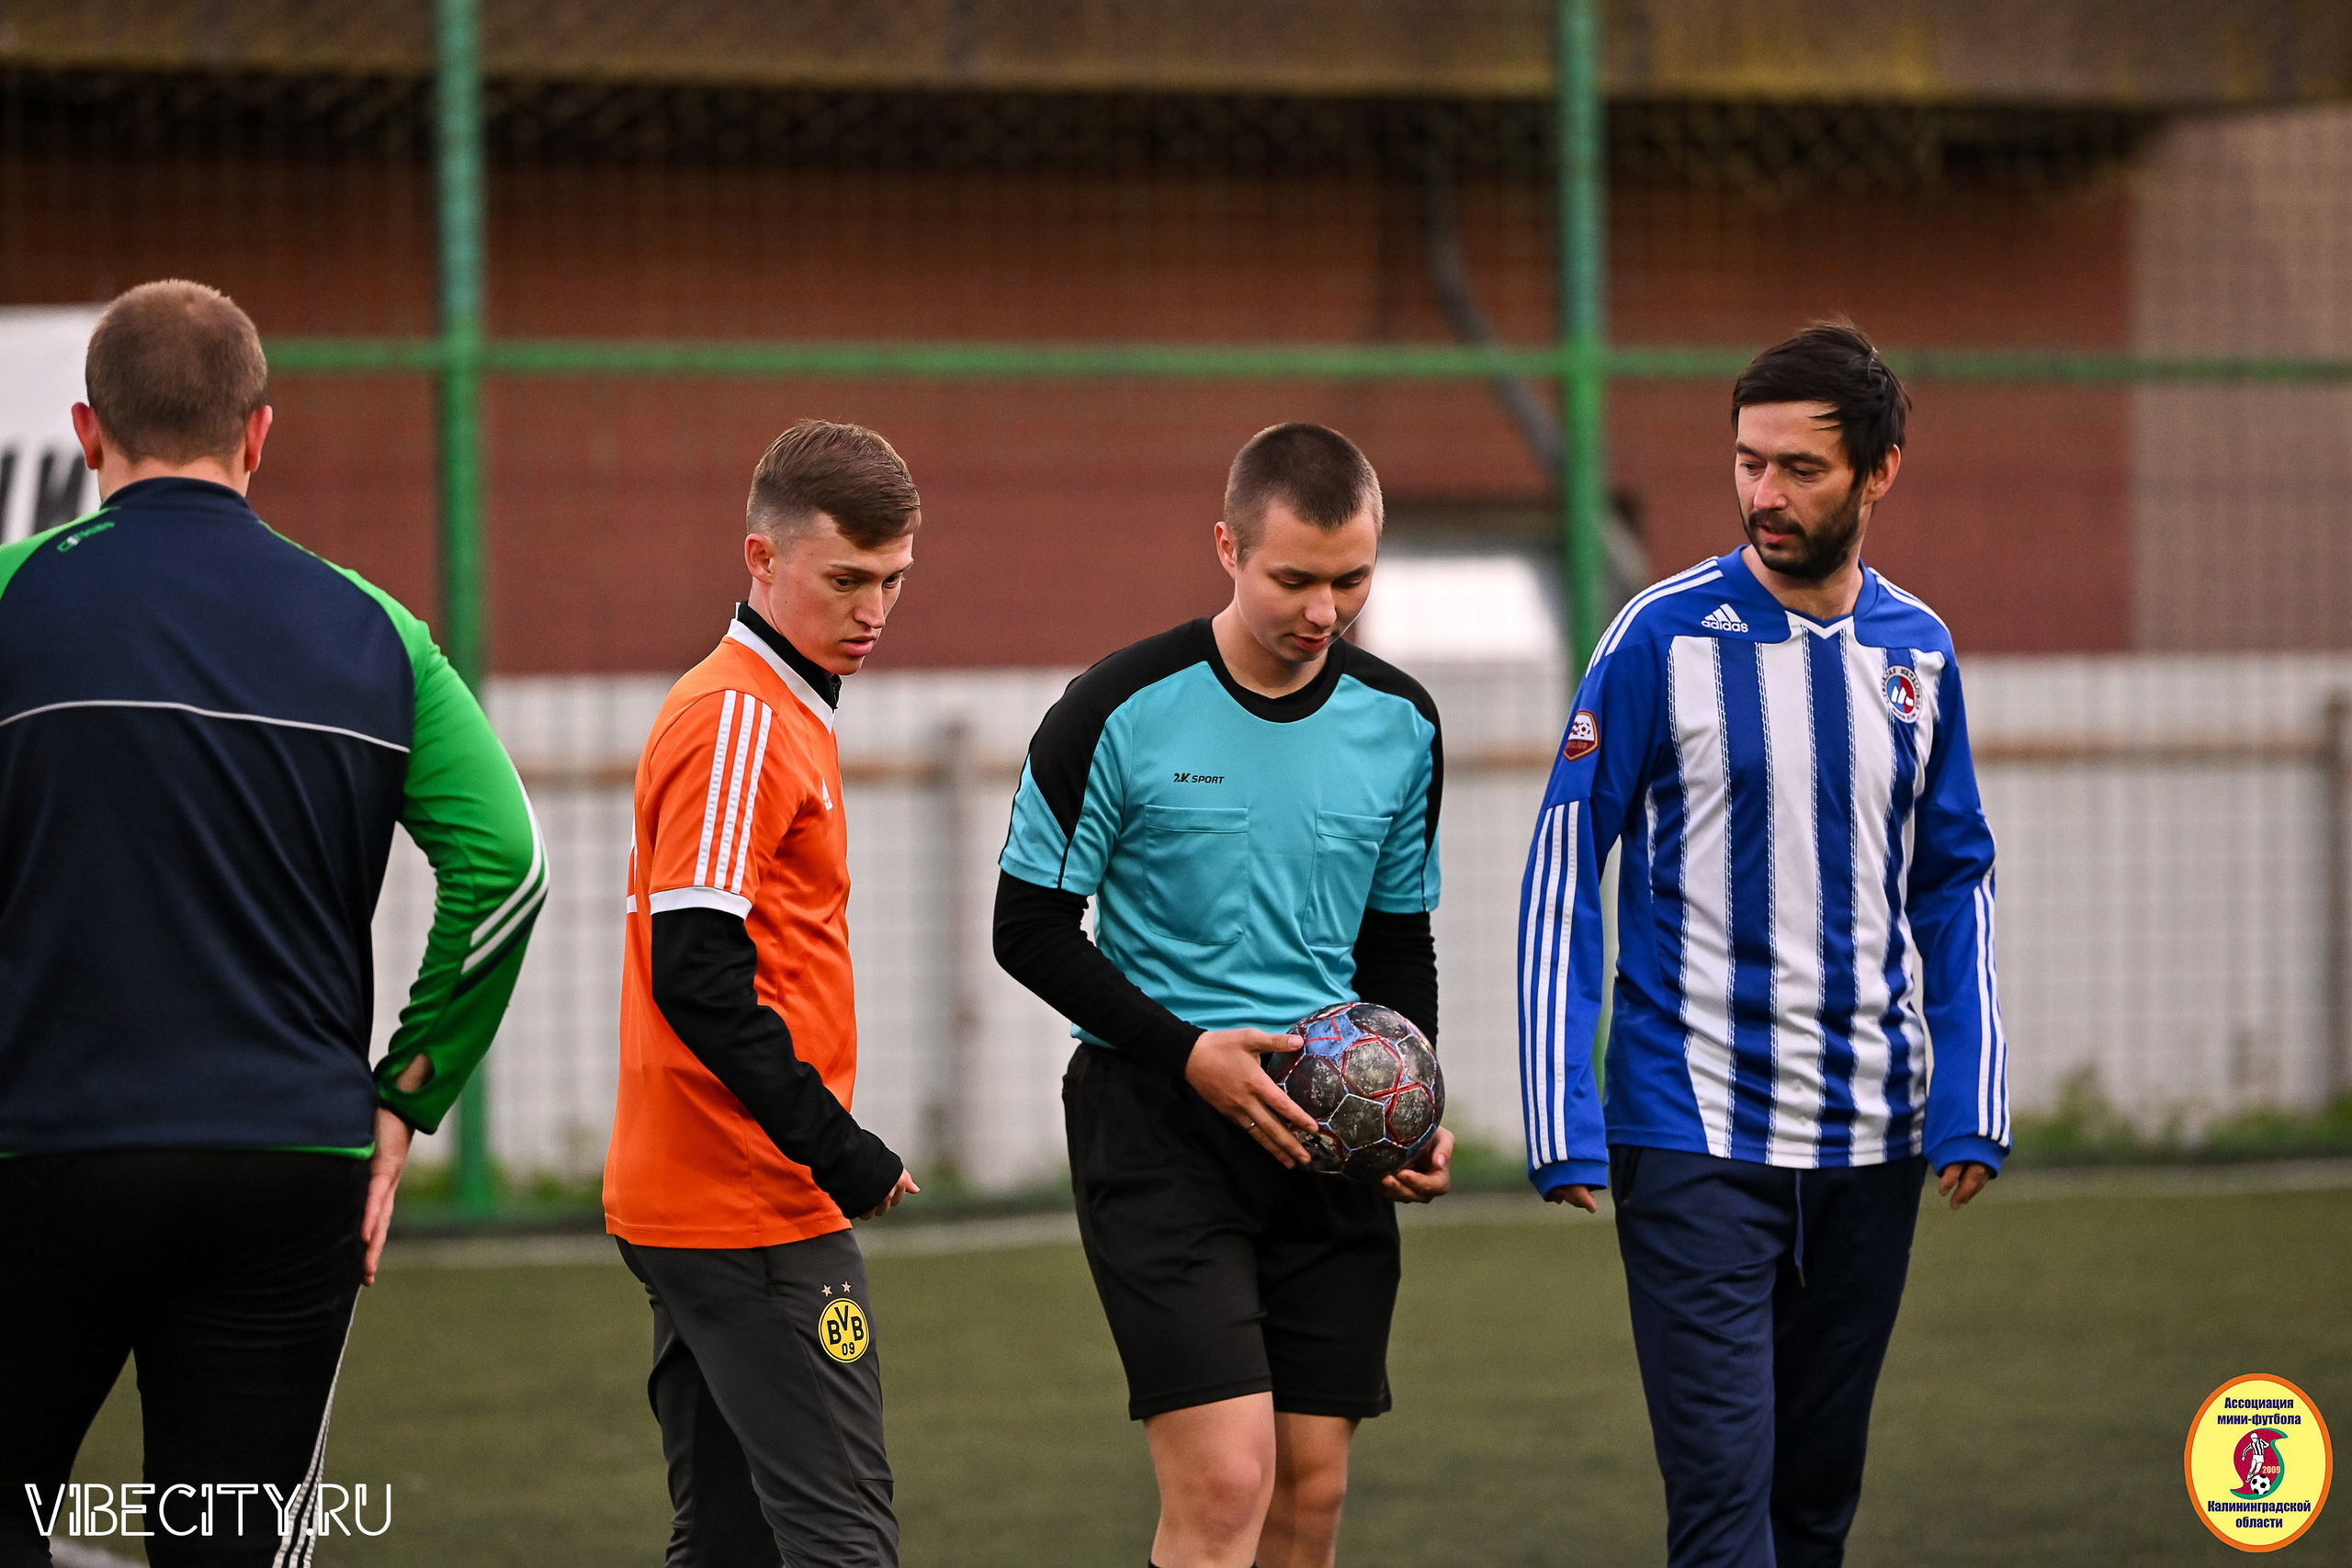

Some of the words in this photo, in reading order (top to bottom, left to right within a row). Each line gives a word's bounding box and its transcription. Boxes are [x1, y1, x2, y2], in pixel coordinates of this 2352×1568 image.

[1701, 619, 1749, 633] adidas
[1173, 773, 1191, 783] 2K
[1192, 774, 1225, 784] SPORT
[826, 1304, 865, 1346] BVB
[842, 1342, 855, 1356] 09
